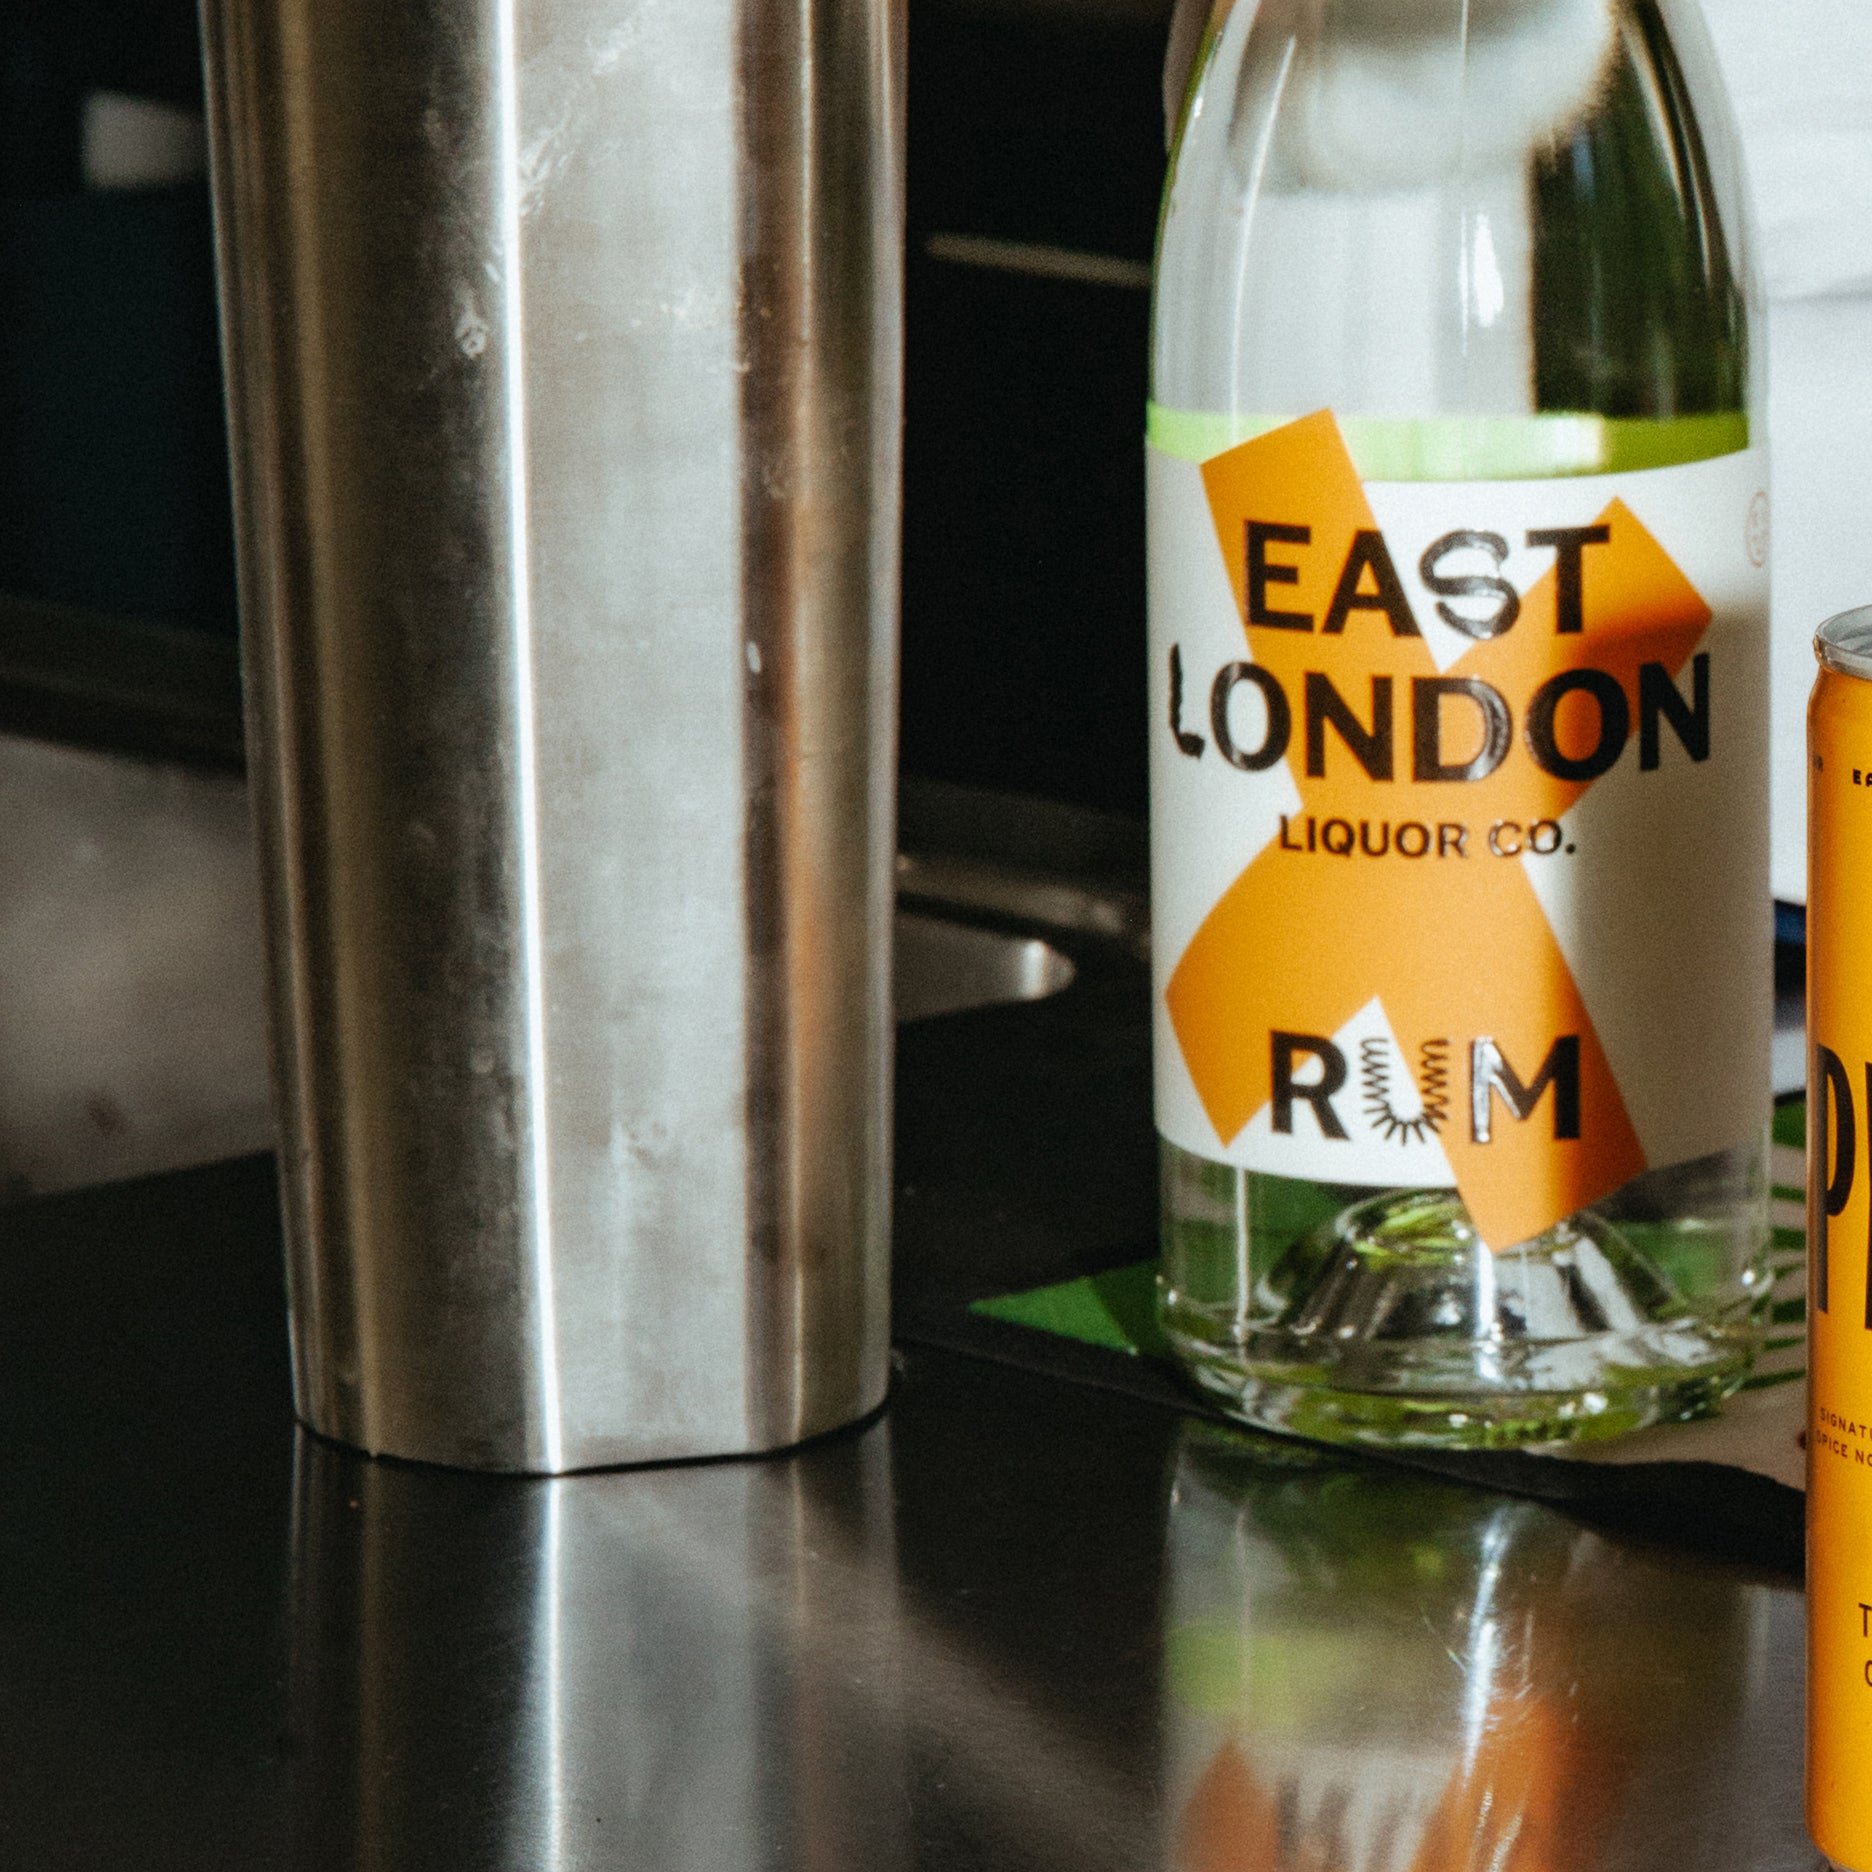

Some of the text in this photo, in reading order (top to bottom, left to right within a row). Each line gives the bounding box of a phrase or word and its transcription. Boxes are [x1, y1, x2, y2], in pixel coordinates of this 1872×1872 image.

[1245, 519, 1611, 641] EAST
[1168, 642, 1711, 785] LONDON
[1279, 814, 1577, 859] LIQUOR CO.
[1269, 1029, 1582, 1147] RUM
